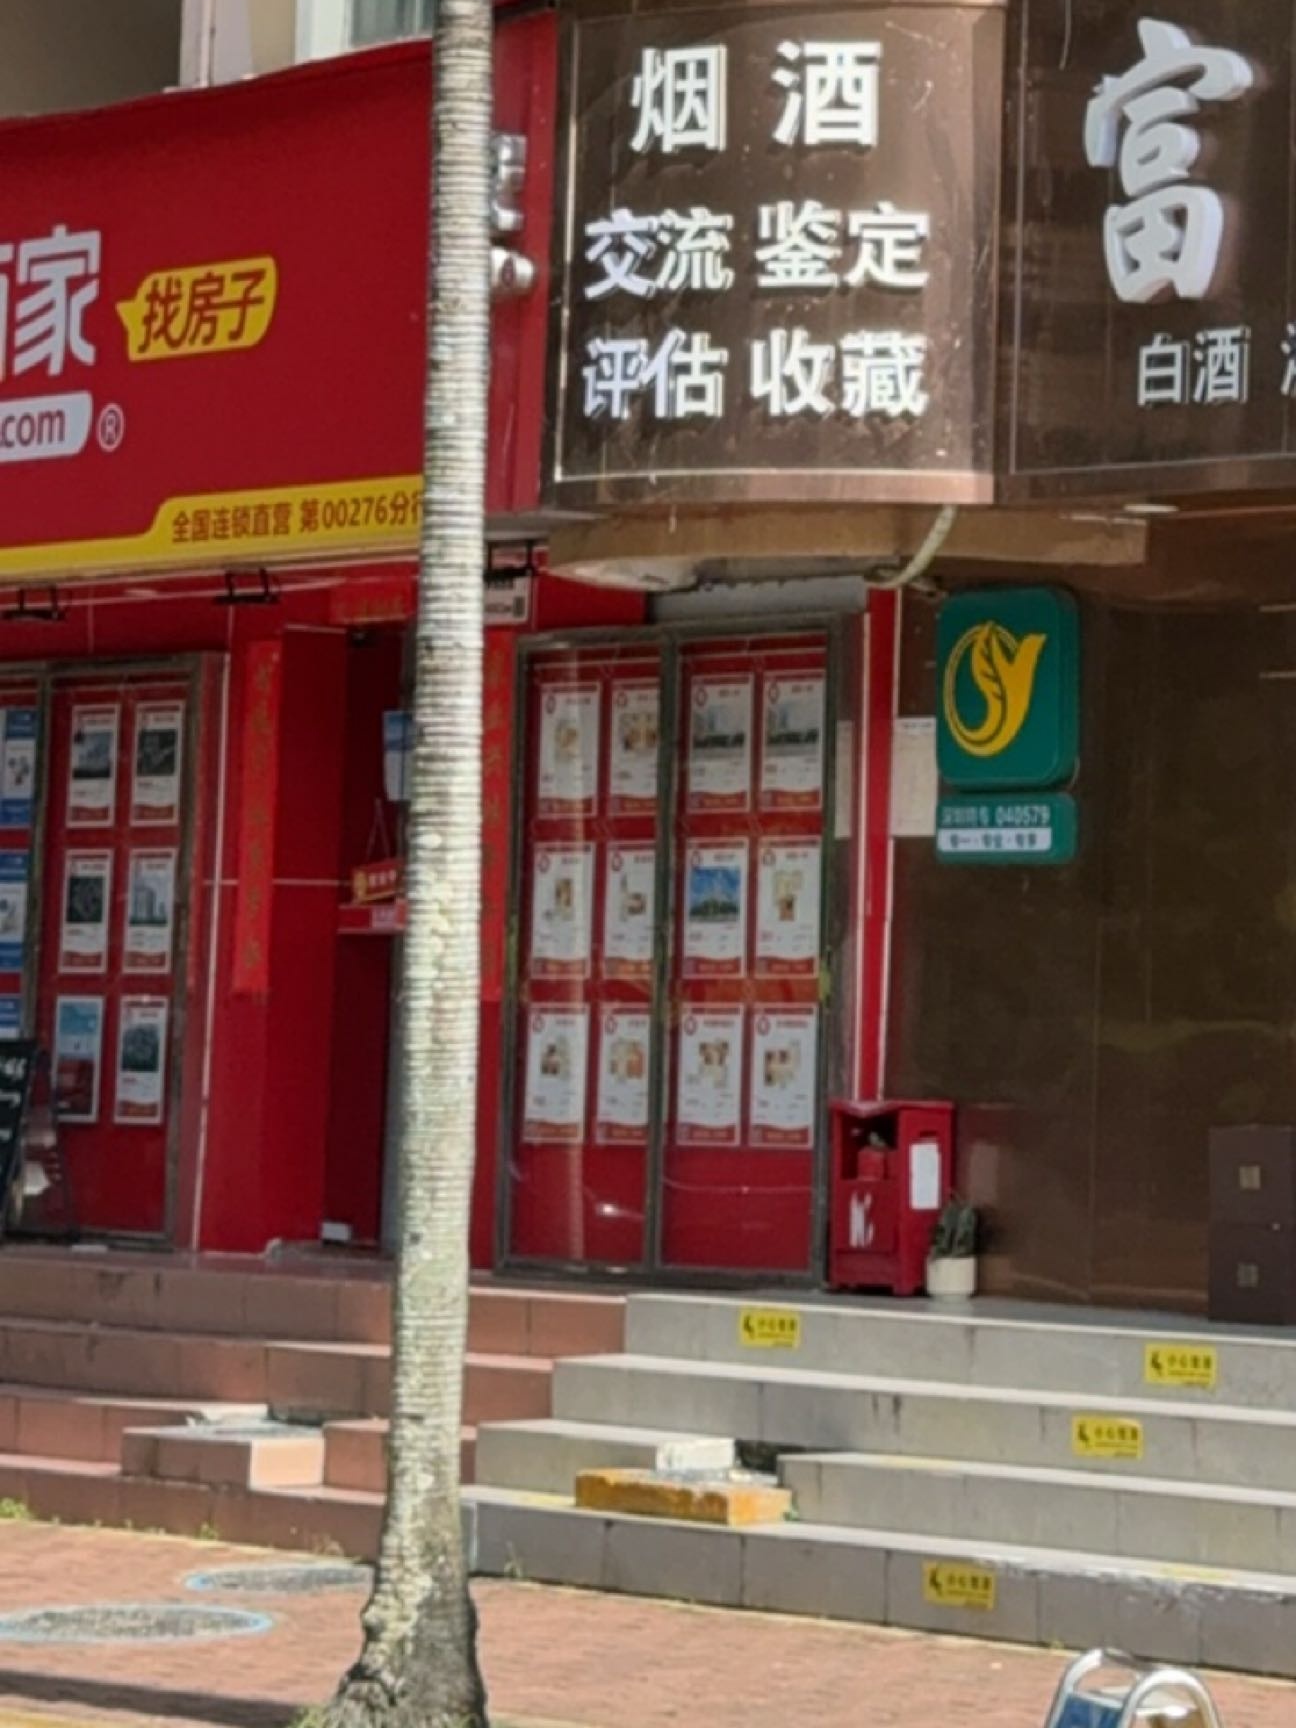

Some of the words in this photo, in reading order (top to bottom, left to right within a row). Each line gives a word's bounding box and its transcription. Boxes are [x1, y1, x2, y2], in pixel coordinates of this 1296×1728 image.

[584, 207, 735, 299] 交流
[755, 199, 930, 290] 鉴定
[0, 223, 102, 383] 家
[137, 267, 266, 354] 找房子
[582, 329, 728, 421] 评估
[751, 327, 930, 420] 收藏
[1136, 325, 1251, 407] 白酒
